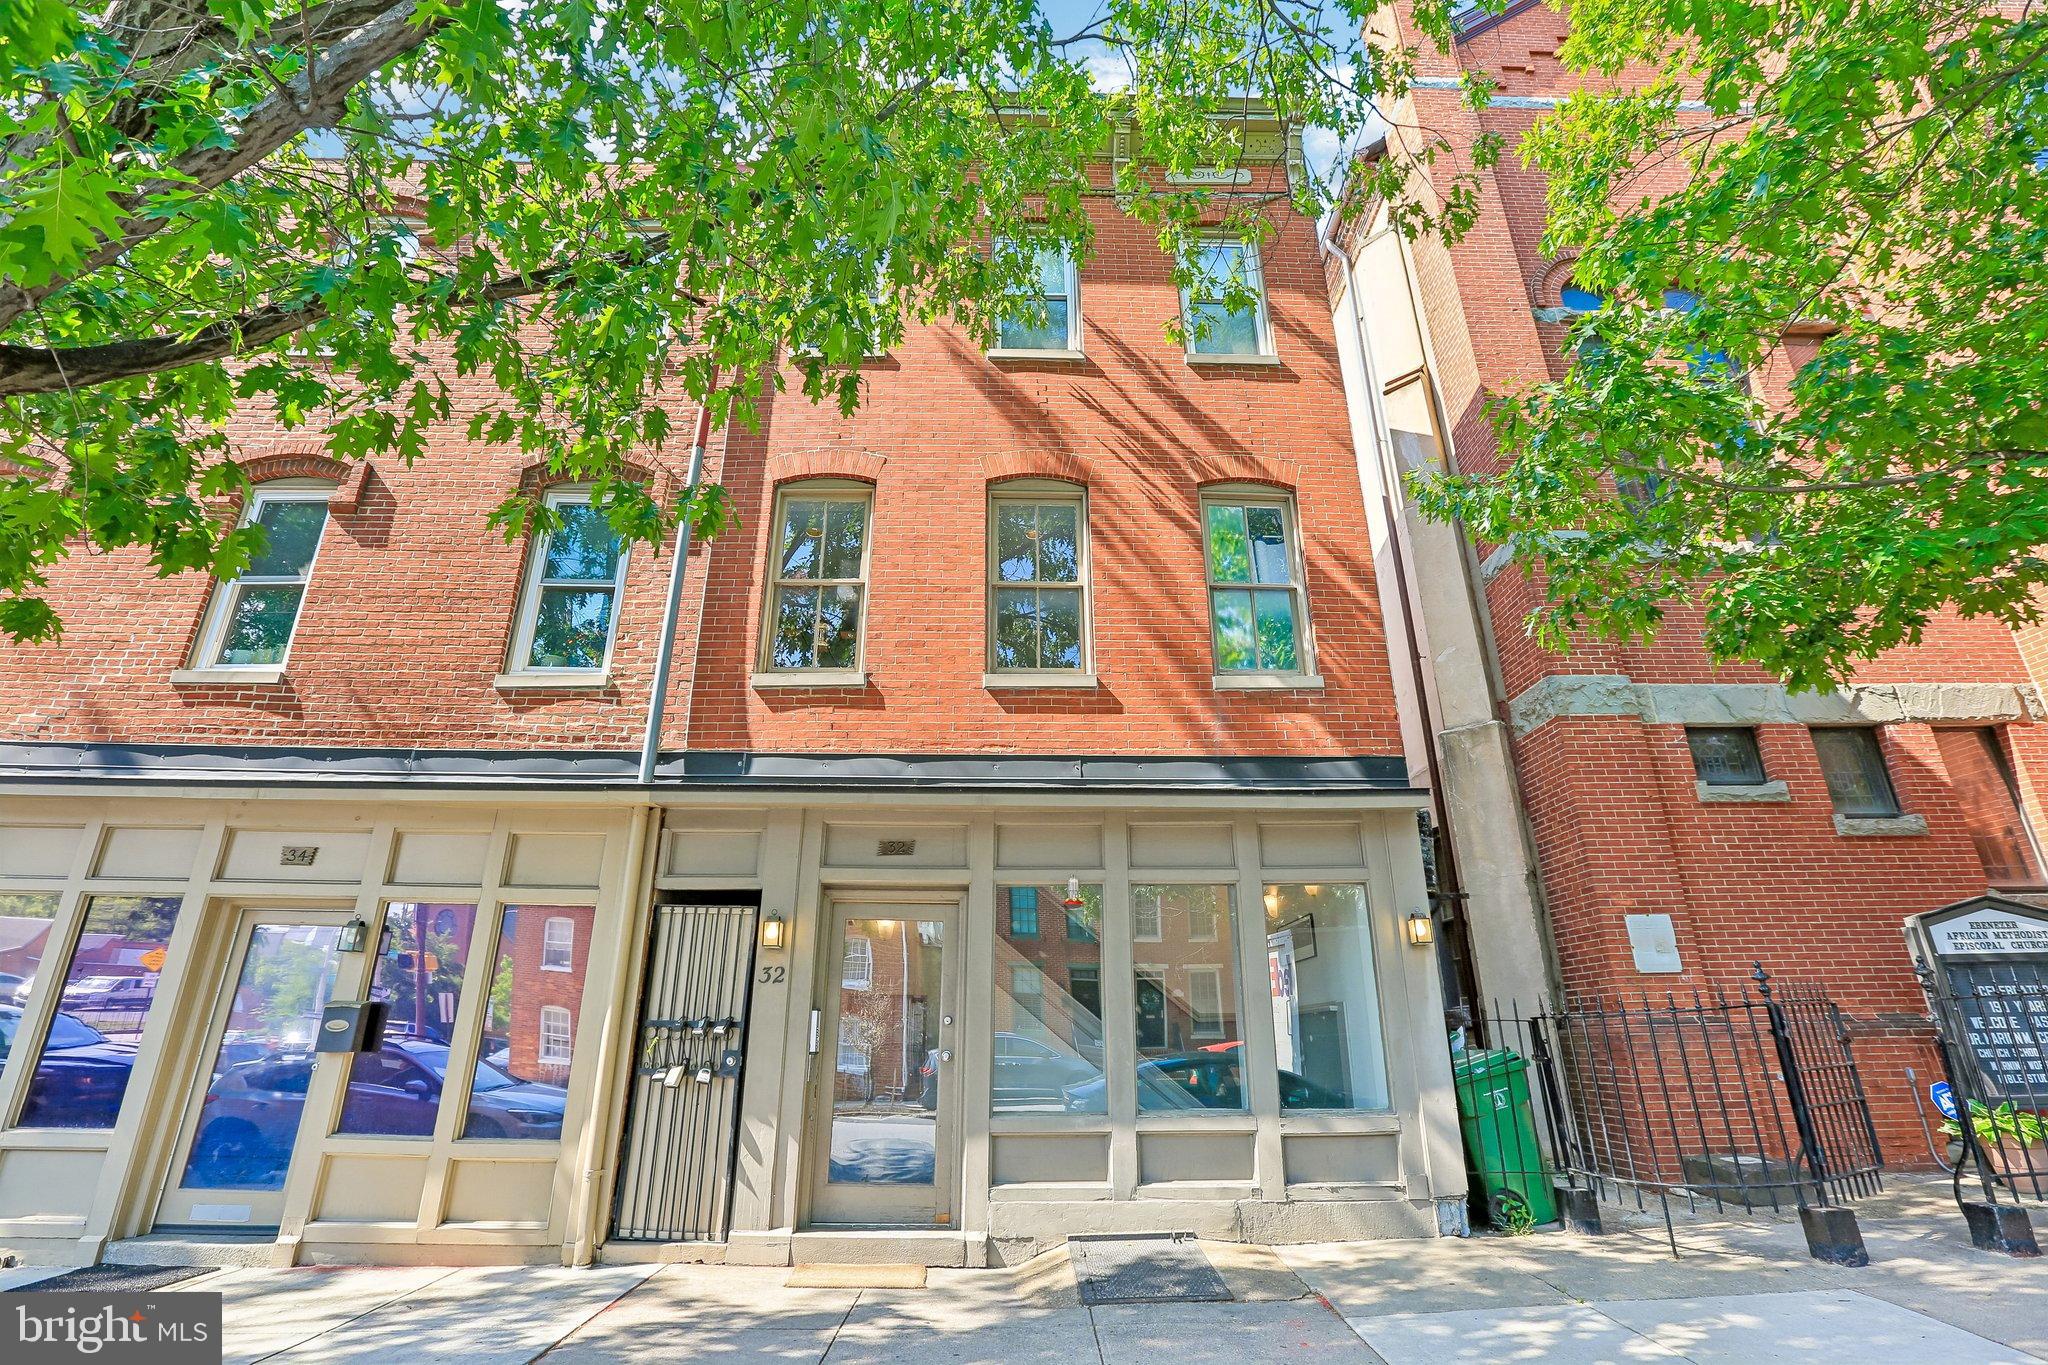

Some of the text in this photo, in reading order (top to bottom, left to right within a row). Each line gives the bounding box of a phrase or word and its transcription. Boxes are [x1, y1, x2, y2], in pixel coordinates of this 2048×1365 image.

[887, 841, 905, 854] 32
[286, 849, 308, 862] 34
[1969, 921, 2018, 930] EBENEZER
[1947, 930, 2048, 940] AFRICAN METHODIST
[1953, 940, 2048, 950] EPISCOPAL CHURCH
[758, 966, 786, 984] 32
[1970, 1016, 2021, 1029] WECOE
[2010, 1047, 2045, 1057] SHOO
